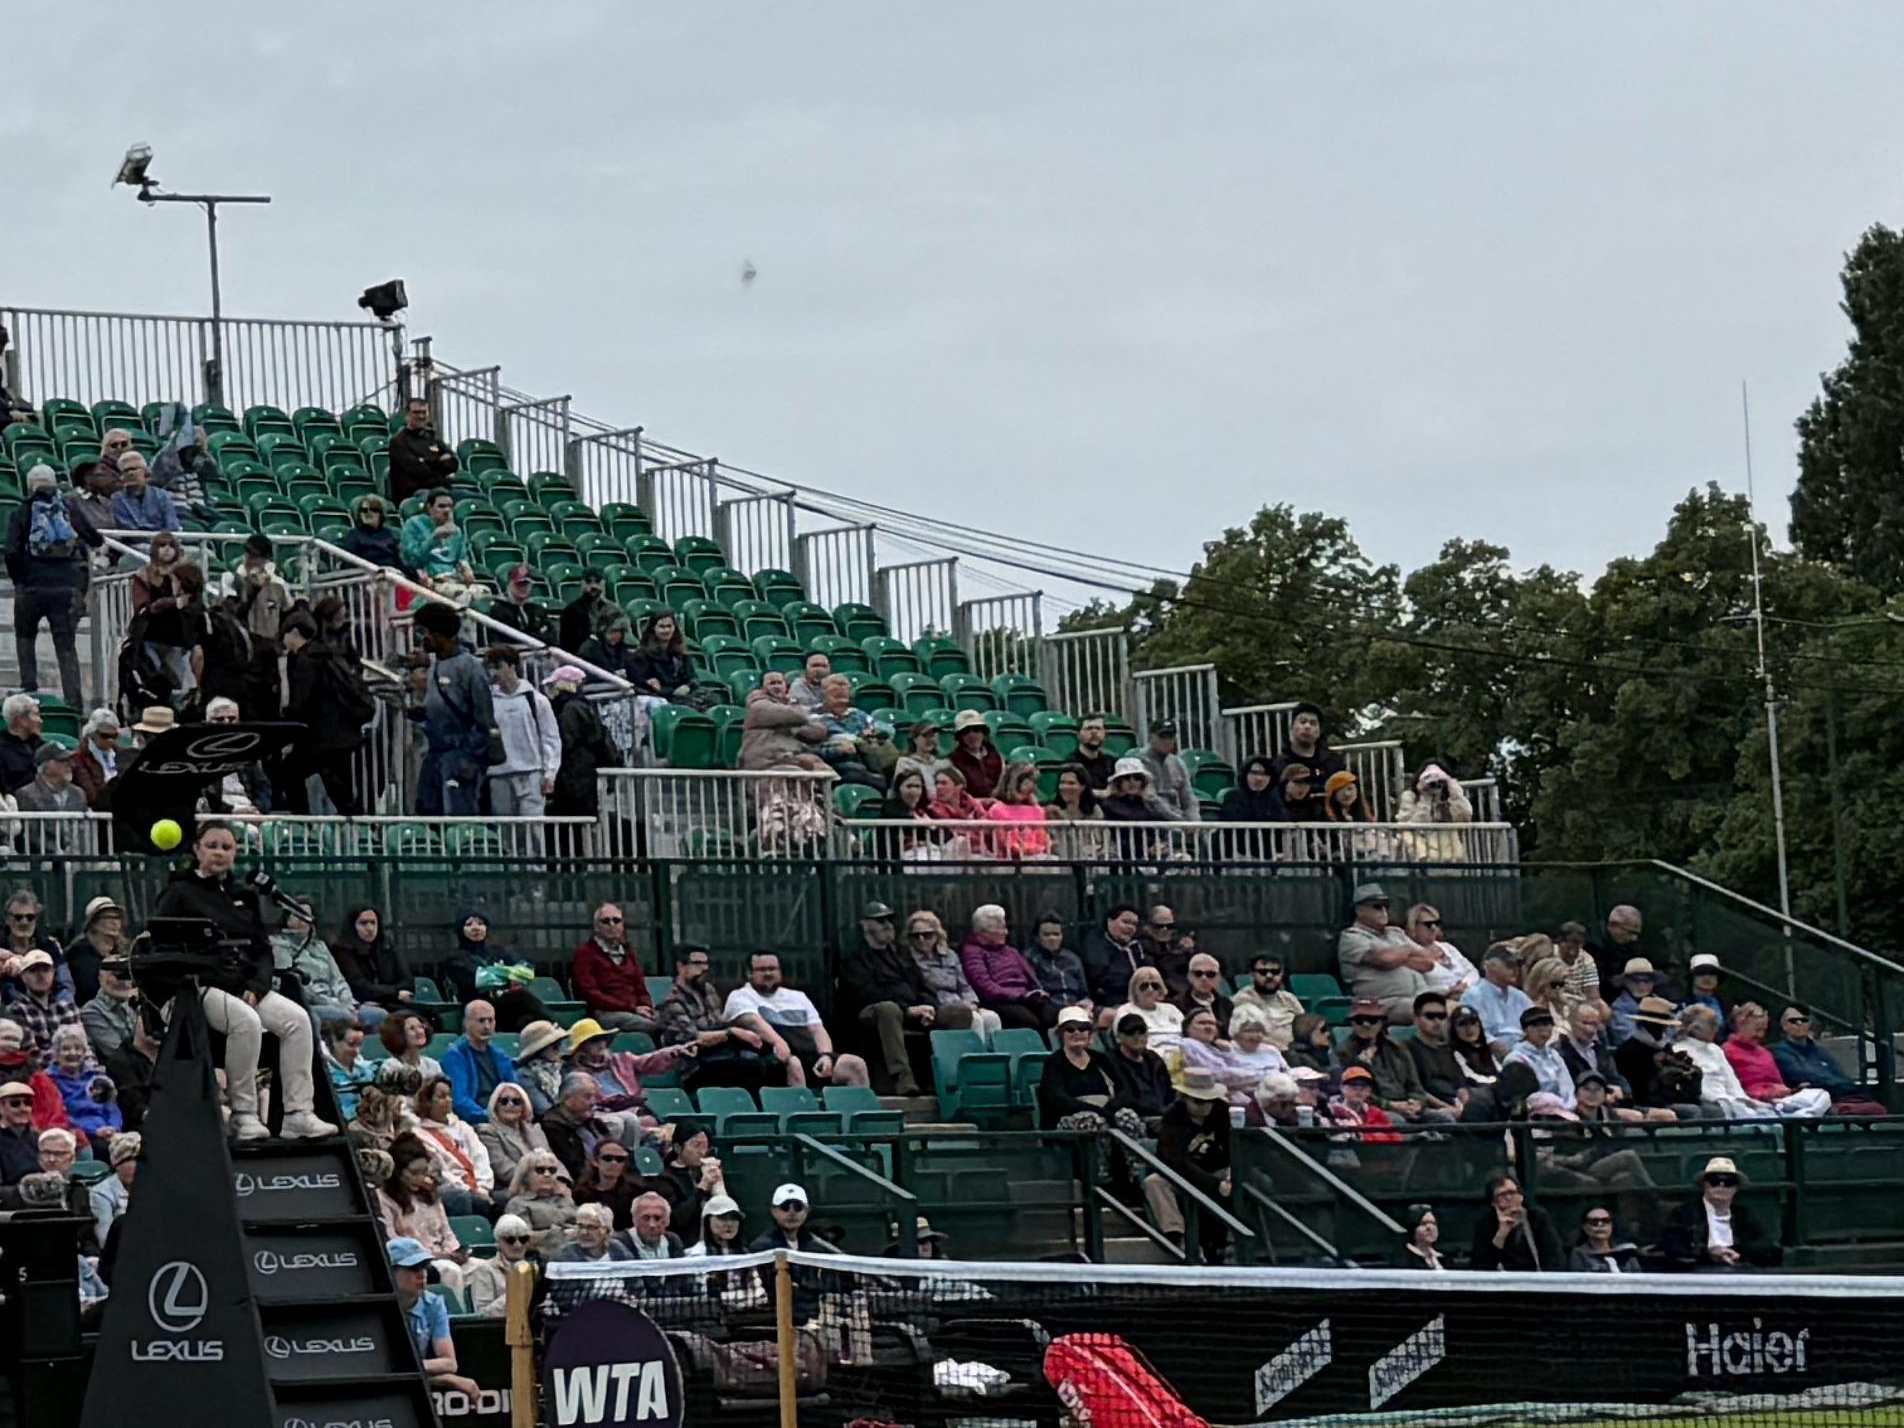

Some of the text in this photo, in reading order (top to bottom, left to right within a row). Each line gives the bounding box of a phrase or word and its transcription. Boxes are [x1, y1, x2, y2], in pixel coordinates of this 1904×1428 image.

[257, 1173, 340, 1191] LEXUS
[279, 1252, 358, 1269] LEXUS
[130, 1340, 224, 1361] LEXUS
[292, 1336, 376, 1353] LEXUS
[1685, 1316, 1811, 1376] Haier
[552, 1360, 669, 1426] WTA
